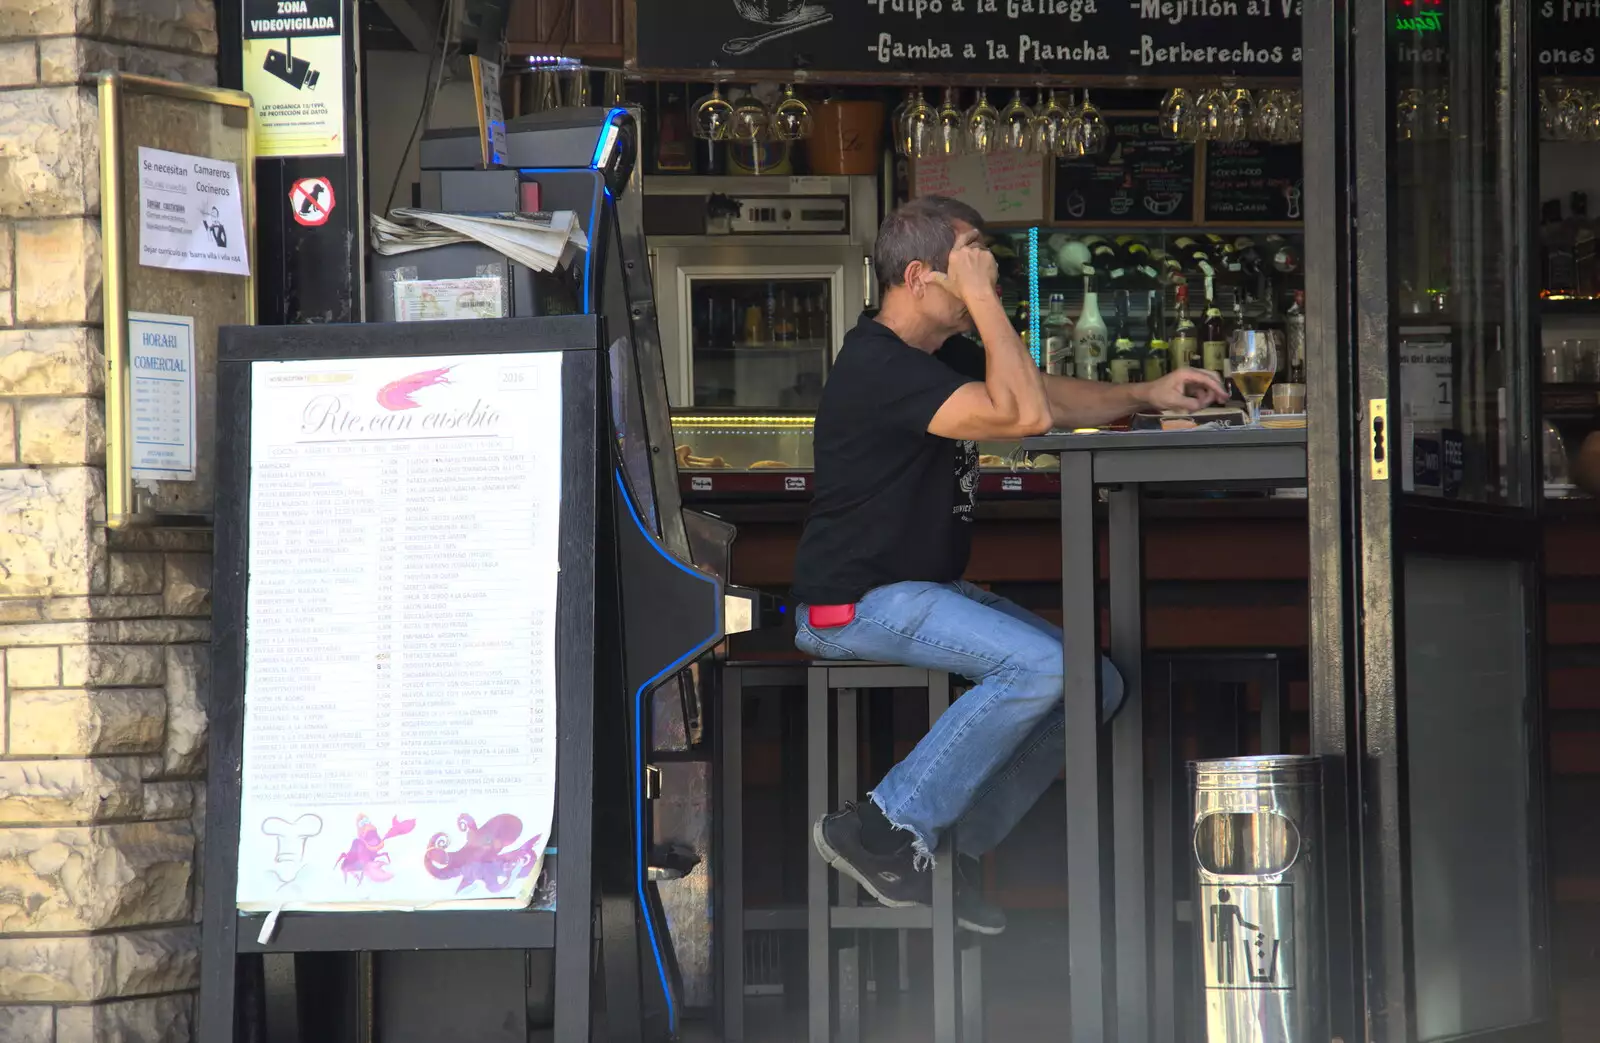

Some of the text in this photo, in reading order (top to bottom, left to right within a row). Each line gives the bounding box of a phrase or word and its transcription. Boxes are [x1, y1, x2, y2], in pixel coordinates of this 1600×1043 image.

[277, 1, 307, 14] ZONA
[250, 16, 334, 32] VIDEOVIGILADA
[962, 44, 976, 58] a
[986, 40, 1009, 60] la
[1018, 34, 1110, 64] Plancha
[143, 160, 188, 177] Se necesitan
[194, 164, 230, 179] Camareros
[196, 182, 230, 196] Cocineros
[142, 332, 177, 348] HORARI
[134, 356, 187, 372] COMERCIAL
[502, 372, 524, 383] 2016
[422, 396, 501, 430] eusebio
